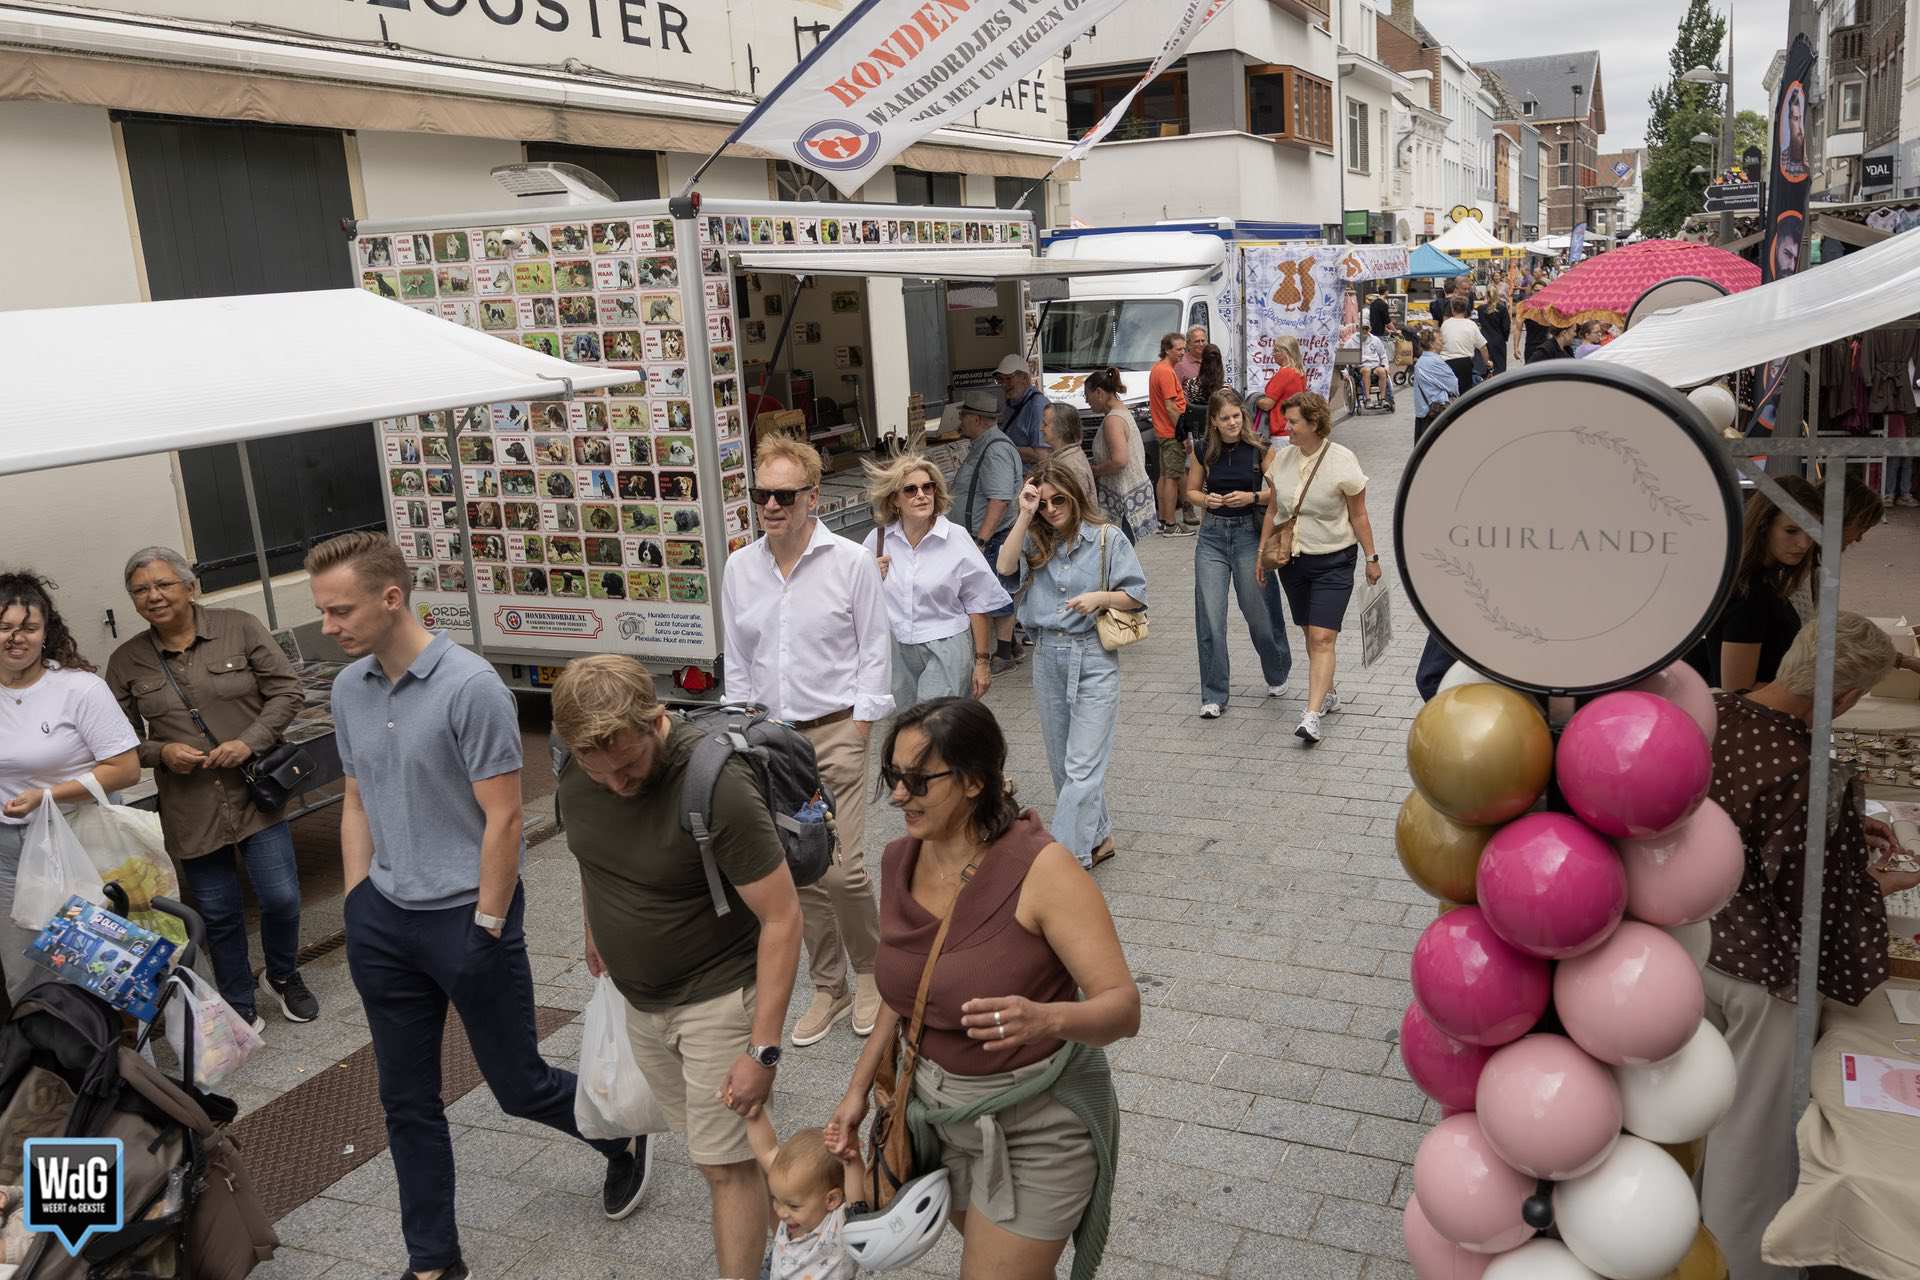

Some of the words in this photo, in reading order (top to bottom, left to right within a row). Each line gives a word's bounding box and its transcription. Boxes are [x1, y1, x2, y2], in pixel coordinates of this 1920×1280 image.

[824, 0, 977, 107] HONDEN
[865, 9, 1012, 127] WAAKBORDJES
[943, 76, 981, 107] MET
[977, 52, 1009, 80] UW
[1006, 6, 1064, 60] EIGEN
[985, 69, 1047, 114] AFÉ
[1449, 525, 1678, 555] GUIRLANDE
